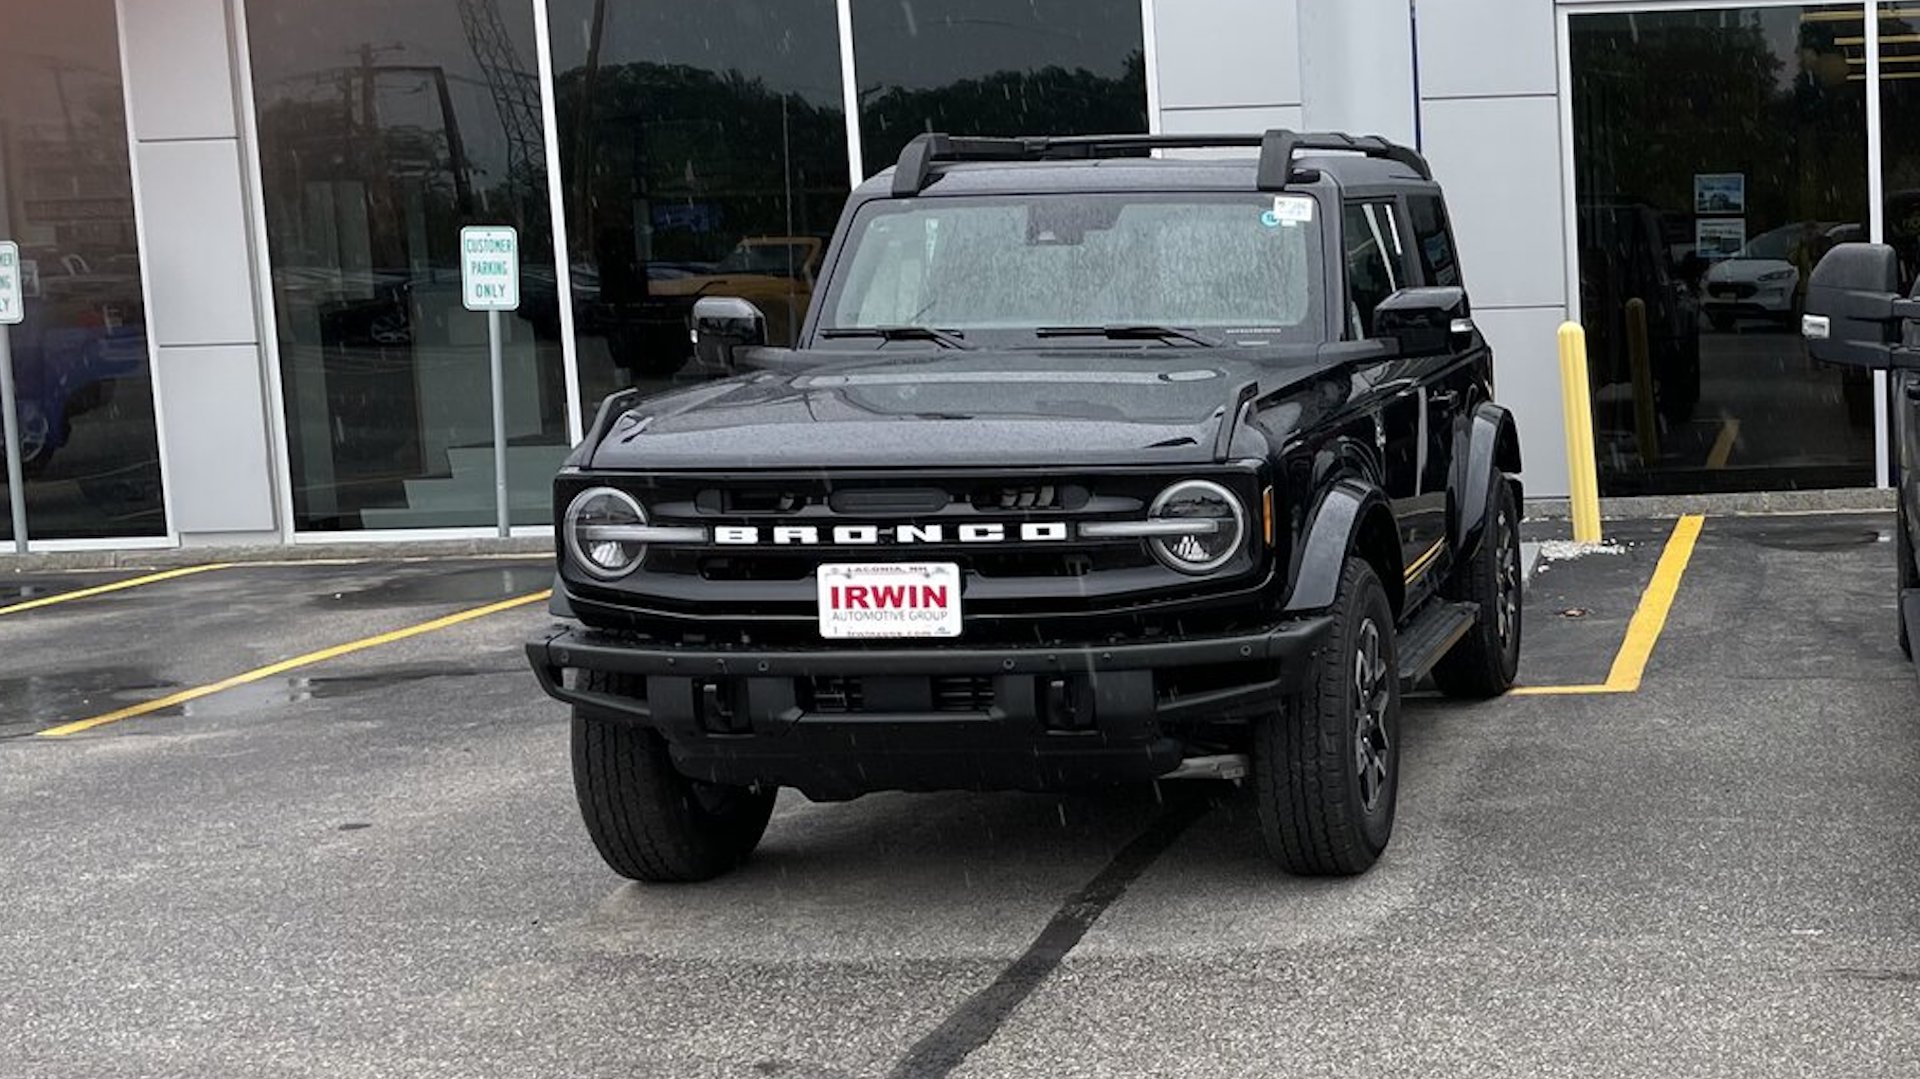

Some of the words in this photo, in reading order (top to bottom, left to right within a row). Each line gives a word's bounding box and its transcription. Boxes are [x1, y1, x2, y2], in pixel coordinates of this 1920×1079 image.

[467, 239, 511, 253] CUSTOMER
[472, 261, 507, 275] PARKING
[476, 284, 505, 298] ONLY
[714, 522, 1066, 544] BRONCO
[831, 585, 947, 609] IRWIN
[832, 611, 905, 621] AUTOMOTIVE
[909, 611, 948, 621] GROUP
